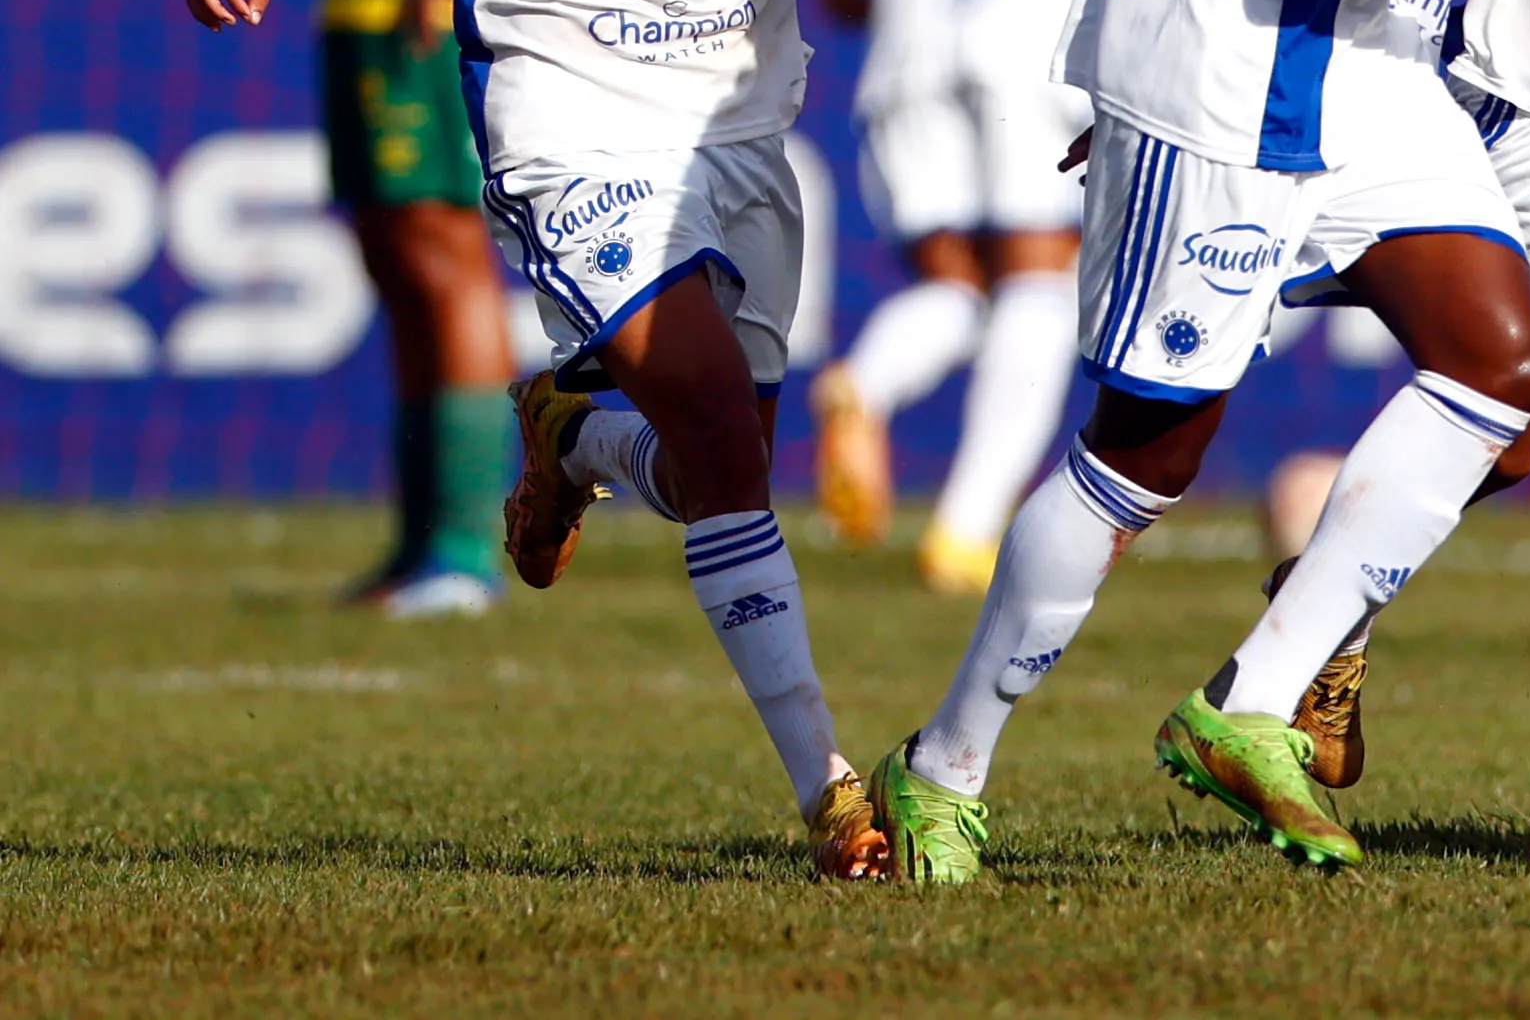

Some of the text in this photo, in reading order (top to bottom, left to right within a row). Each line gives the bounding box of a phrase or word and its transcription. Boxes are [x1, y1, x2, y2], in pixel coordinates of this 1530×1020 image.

[588, 0, 757, 46] Champion
[638, 39, 724, 62] WATCH
[585, 230, 634, 274] CRUZEIRO
